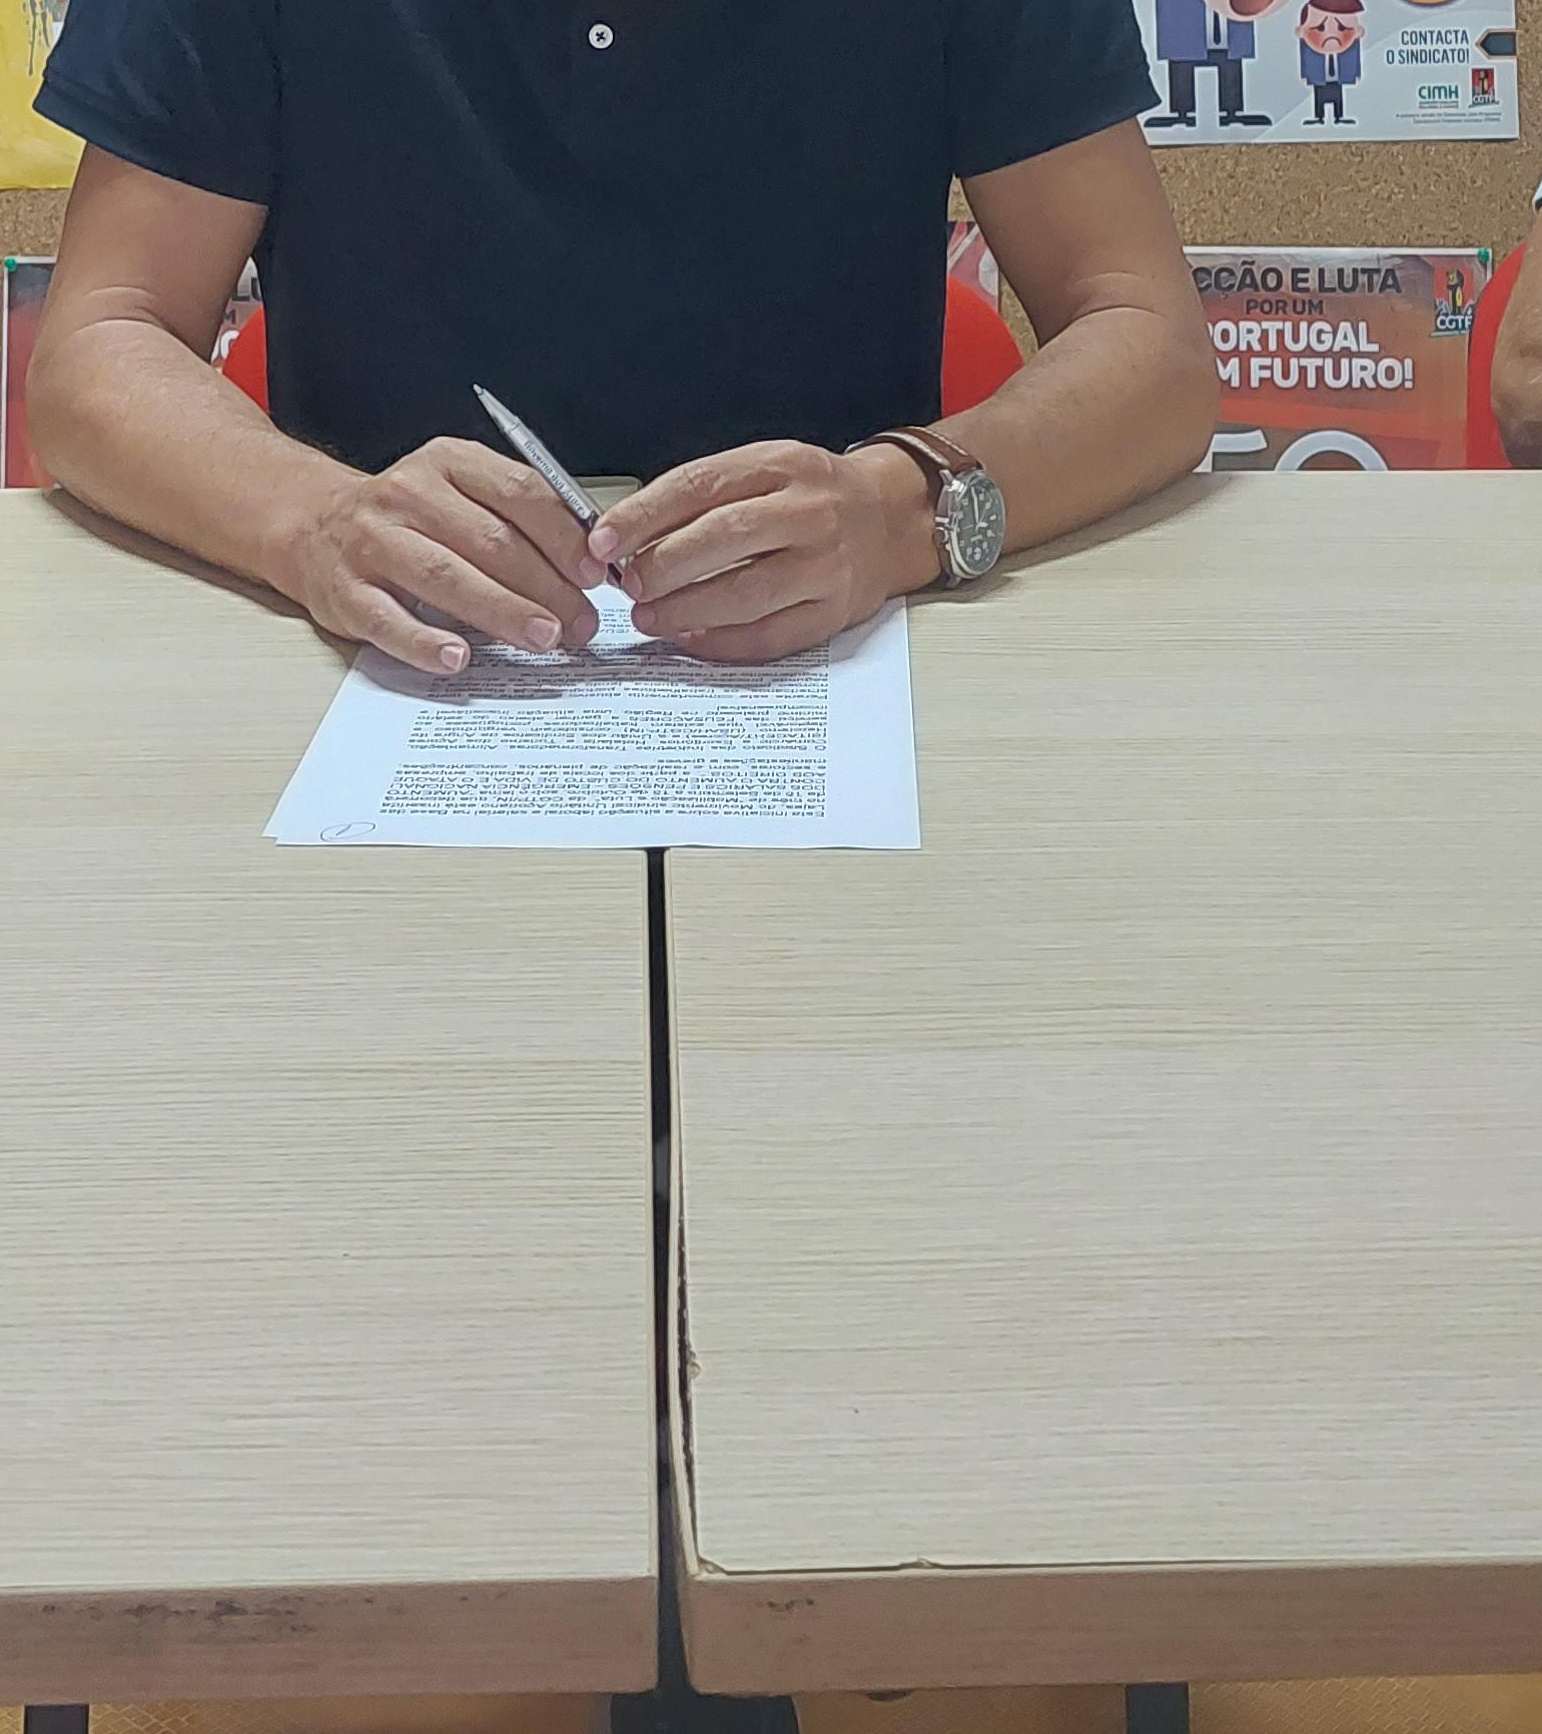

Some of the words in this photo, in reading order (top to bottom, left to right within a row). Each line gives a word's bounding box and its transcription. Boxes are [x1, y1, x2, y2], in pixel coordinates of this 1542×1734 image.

[1401, 30, 1469, 47] CONTACTA
[1386, 49, 1395, 65] O
[1398, 48, 1470, 65] SINDICATO!
[1418, 85, 1459, 100] CIMH
[1192, 260, 1283, 299] CÇÃO
[1291, 268, 1310, 292] E
[1318, 267, 1401, 293] LUTA
[1246, 300, 1287, 314] POR
[1293, 300, 1323, 314] UM
[1208, 320, 1379, 352] ORTUGAL
[1250, 358, 1413, 389] FUTURO!
